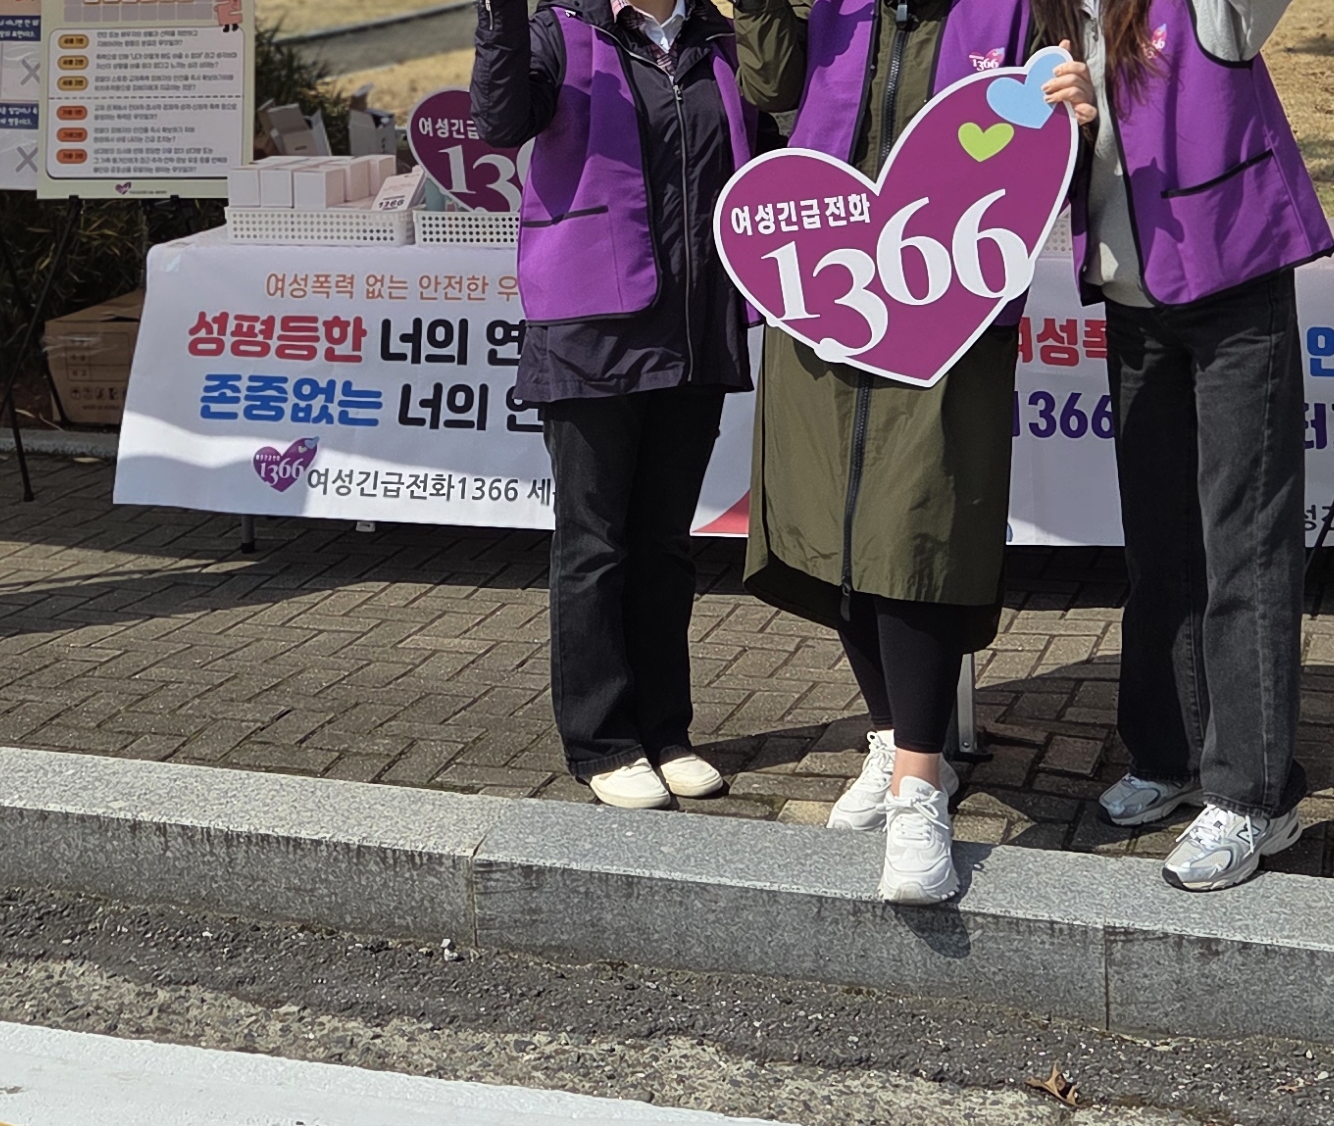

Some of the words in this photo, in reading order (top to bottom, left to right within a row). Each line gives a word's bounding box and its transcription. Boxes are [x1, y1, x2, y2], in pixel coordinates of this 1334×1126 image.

[731, 193, 871, 236] 여성긴급전화
[266, 273, 355, 300] 여성폭력
[365, 274, 409, 301] 없는
[418, 274, 489, 302] 안전한
[761, 189, 1033, 356] 1366
[188, 311, 367, 364] 성평등한
[380, 317, 469, 366] 너의
[200, 373, 383, 427] 존중없는
[398, 382, 490, 432] 너의
[260, 458, 305, 485] 1366
[307, 467, 519, 502] 여성긴급전화1366
[527, 477, 556, 506] 세
